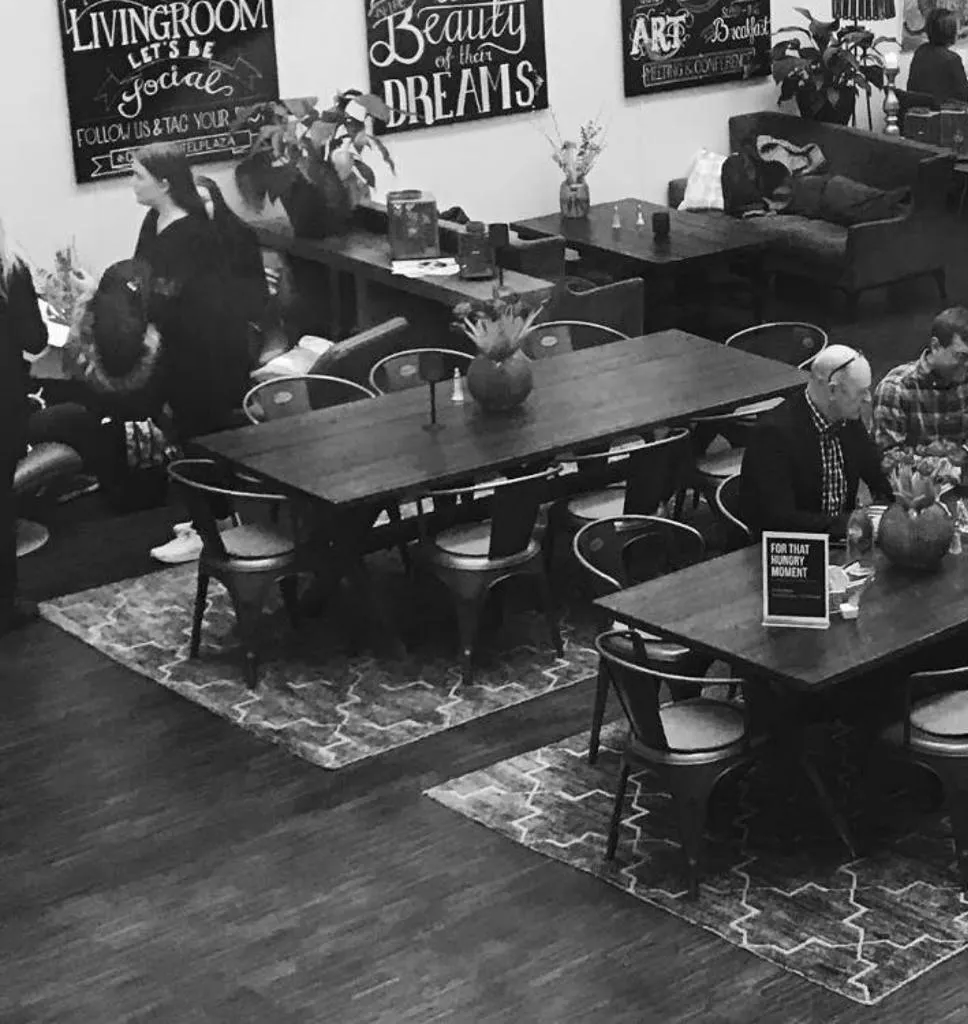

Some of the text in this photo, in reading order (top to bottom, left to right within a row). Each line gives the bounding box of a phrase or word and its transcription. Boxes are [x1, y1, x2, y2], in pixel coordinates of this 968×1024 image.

[630, 15, 688, 56] ART
[127, 40, 216, 69] LET'S BE
[383, 60, 535, 128] DREAMS
[76, 122, 131, 148] FOLLOW
[193, 109, 229, 129] YOUR
[771, 543, 810, 555] FOR THAT
[771, 555, 804, 566] HUNGRY
[771, 566, 808, 578] MOMENT
